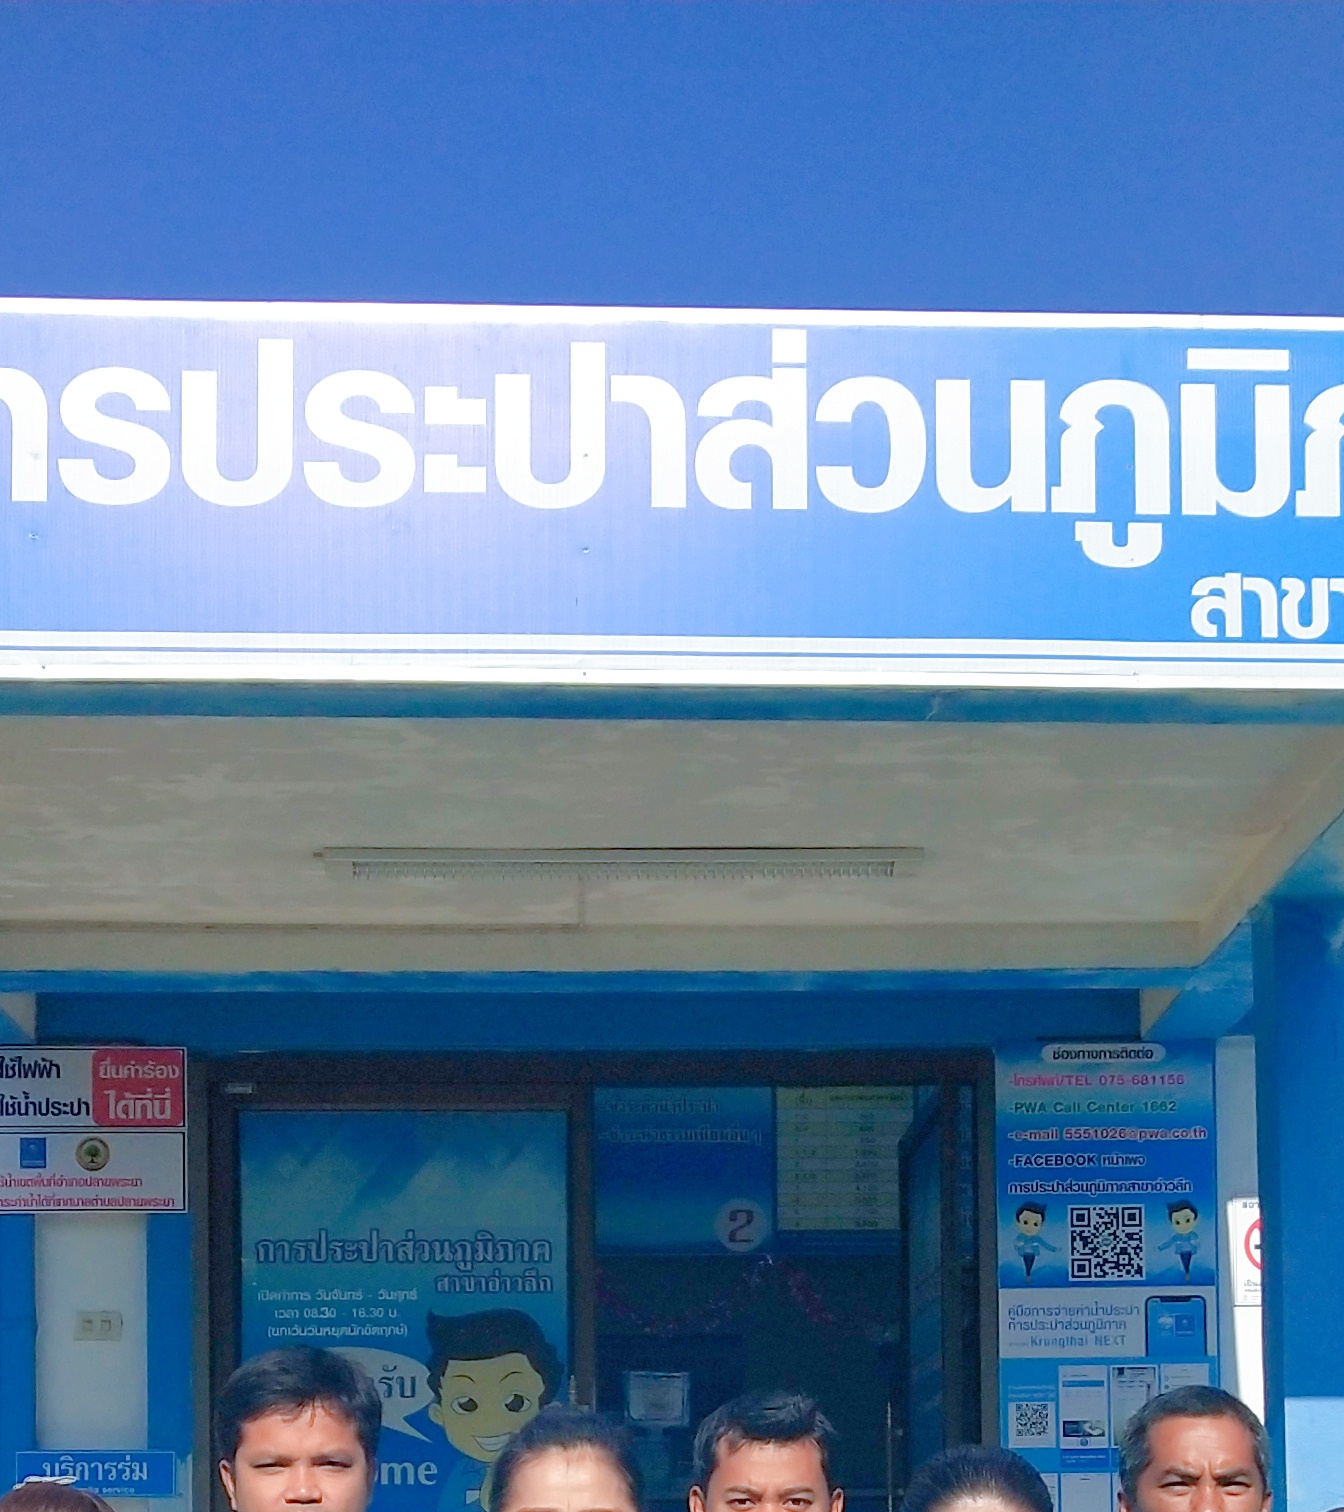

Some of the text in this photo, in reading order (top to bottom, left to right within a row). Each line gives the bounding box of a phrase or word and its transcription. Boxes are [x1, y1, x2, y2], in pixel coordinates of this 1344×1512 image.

[1052, 1046, 1154, 1061] ช่องทางการติดต่อ
[99, 1060, 180, 1080] ยื่นคำร้อง
[104, 1087, 172, 1120] ได้ที่นี่
[1053, 1102, 1081, 1113] Call
[1087, 1102, 1134, 1113] Center
[1143, 1100, 1177, 1113] 1662
[1008, 1178, 1193, 1197] การประปาส่วนภูมิภาคสาขาอ่าวลึก
[728, 1208, 754, 1243] 2
[257, 1228, 552, 1271] การประปาส่วนภูมิภาค
[434, 1269, 553, 1293] สาขาอ่าวลึก
[303, 1307, 337, 1319] 08.30
[1030, 1335, 1088, 1349] Krungthai
[1094, 1335, 1126, 1347] NEXT
